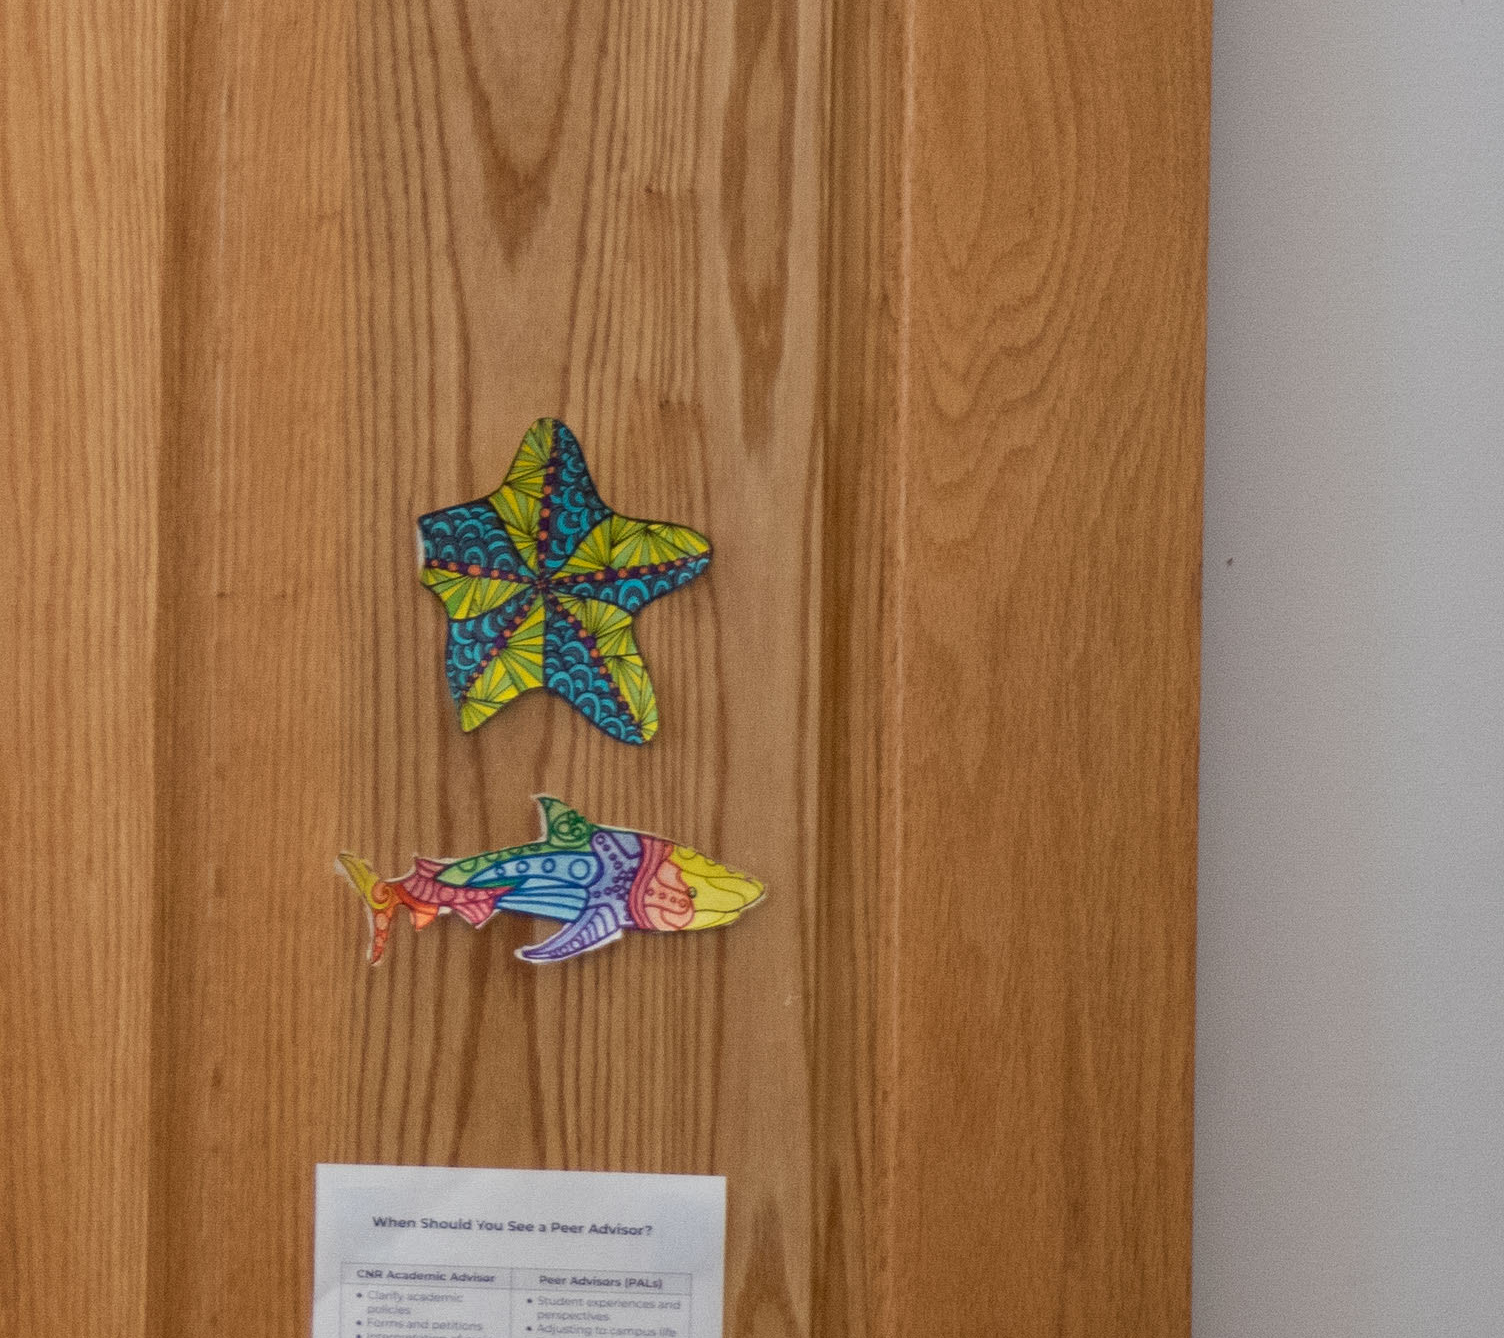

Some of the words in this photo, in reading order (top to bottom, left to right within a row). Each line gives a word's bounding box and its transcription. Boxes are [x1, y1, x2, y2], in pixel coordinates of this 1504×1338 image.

[373, 1216, 416, 1228] When
[421, 1217, 472, 1230] Should
[476, 1220, 503, 1231] You
[508, 1221, 534, 1232] See
[539, 1223, 546, 1232] a
[551, 1222, 584, 1234] Peer
[588, 1224, 652, 1235] Advisor?
[356, 1269, 383, 1279] CNR
[387, 1270, 446, 1281] Academic
[450, 1273, 496, 1282] Advisor
[539, 1276, 567, 1285] Peer
[570, 1276, 621, 1287] Advisors
[625, 1278, 663, 1289] (PALs)
